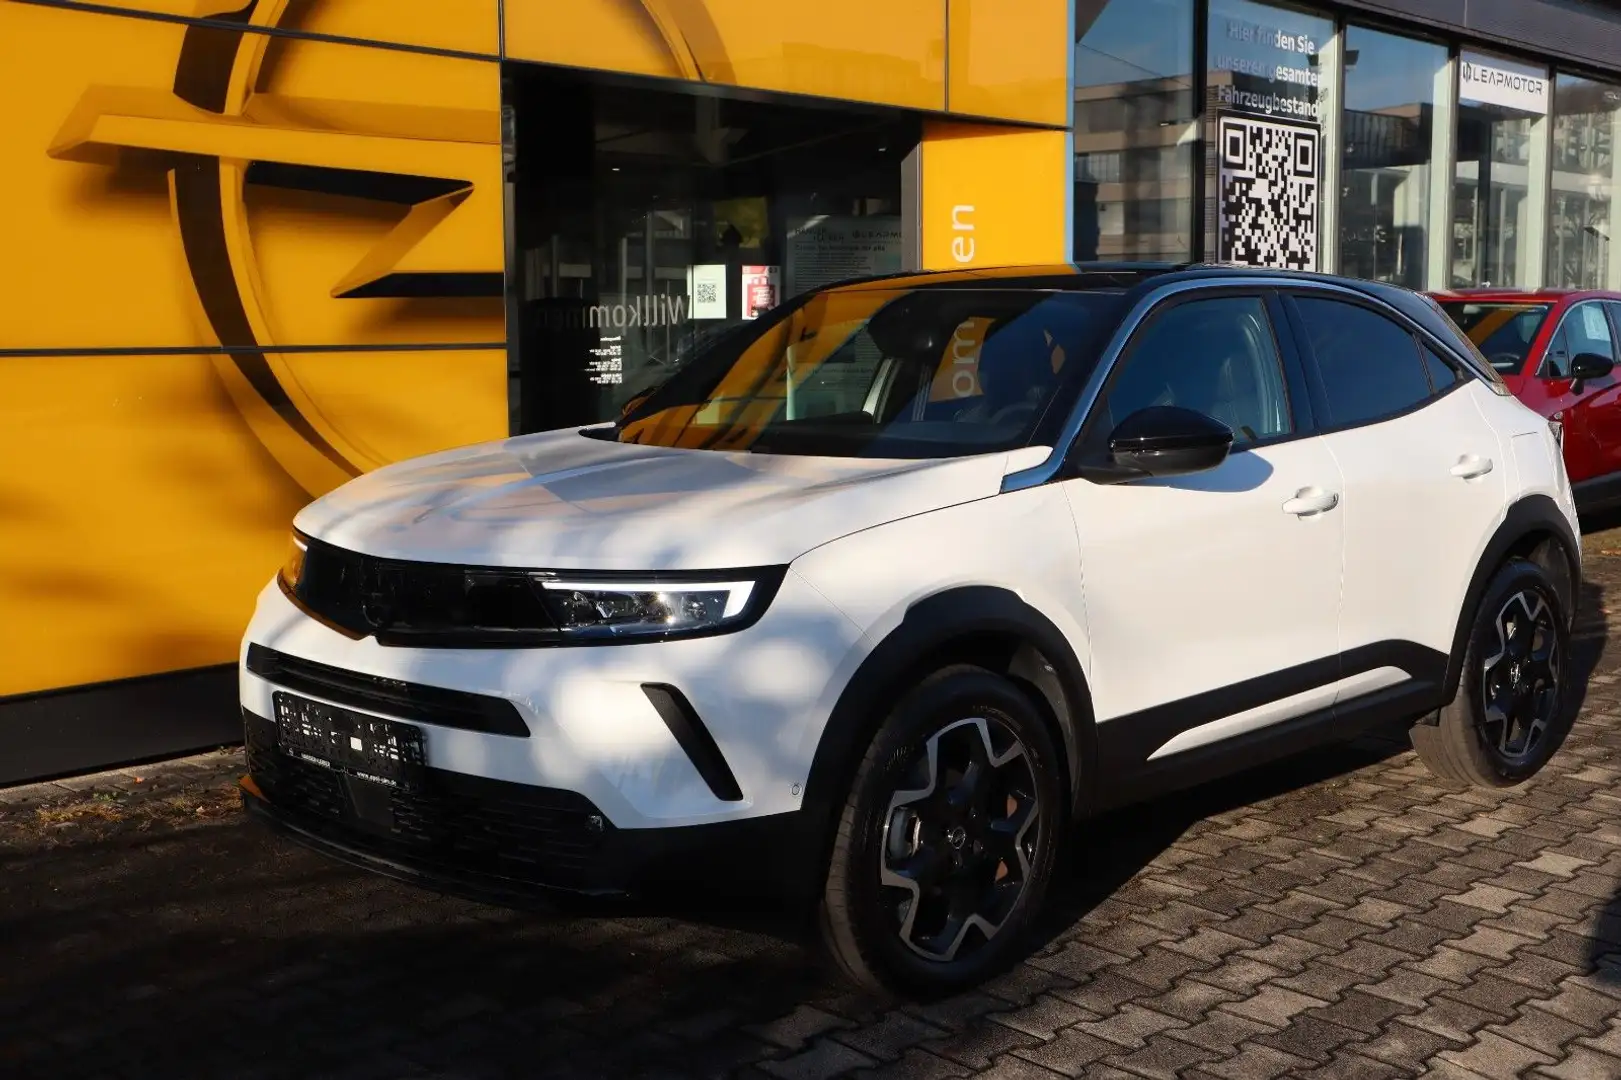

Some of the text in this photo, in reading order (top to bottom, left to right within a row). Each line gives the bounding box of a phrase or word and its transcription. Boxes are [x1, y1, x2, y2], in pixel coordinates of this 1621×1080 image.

[1230, 20, 1315, 54] Hier finden Sie
[1217, 55, 1265, 76] unseren
[1473, 69, 1542, 95] LEAPMOTOR
